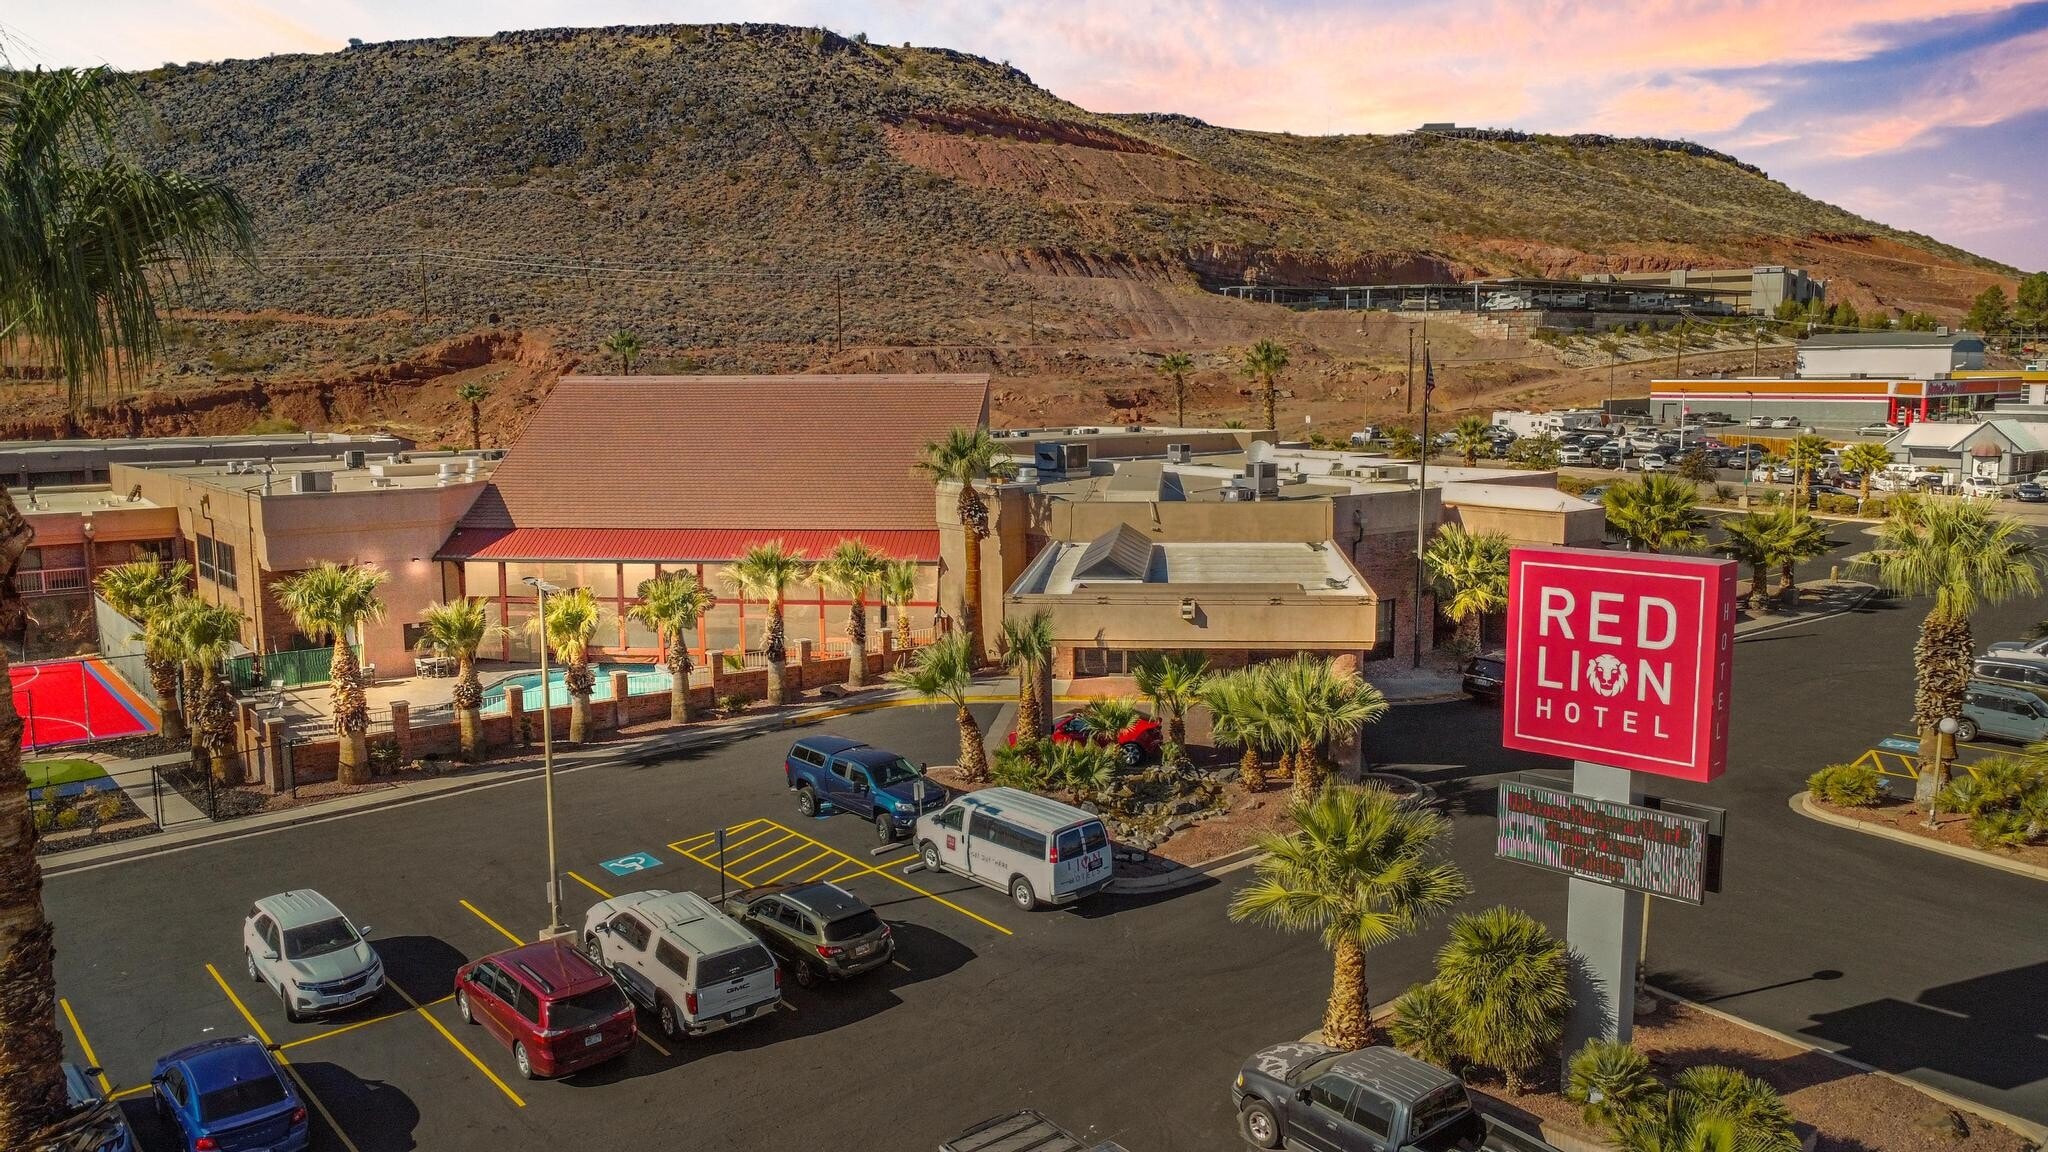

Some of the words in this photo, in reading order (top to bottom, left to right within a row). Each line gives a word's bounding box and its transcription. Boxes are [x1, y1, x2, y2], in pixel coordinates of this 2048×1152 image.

[1539, 586, 1678, 650] RED
[1715, 602, 1730, 740] HOTEL
[1536, 697, 1669, 739] HOTEL
[727, 983, 751, 993] GMC
